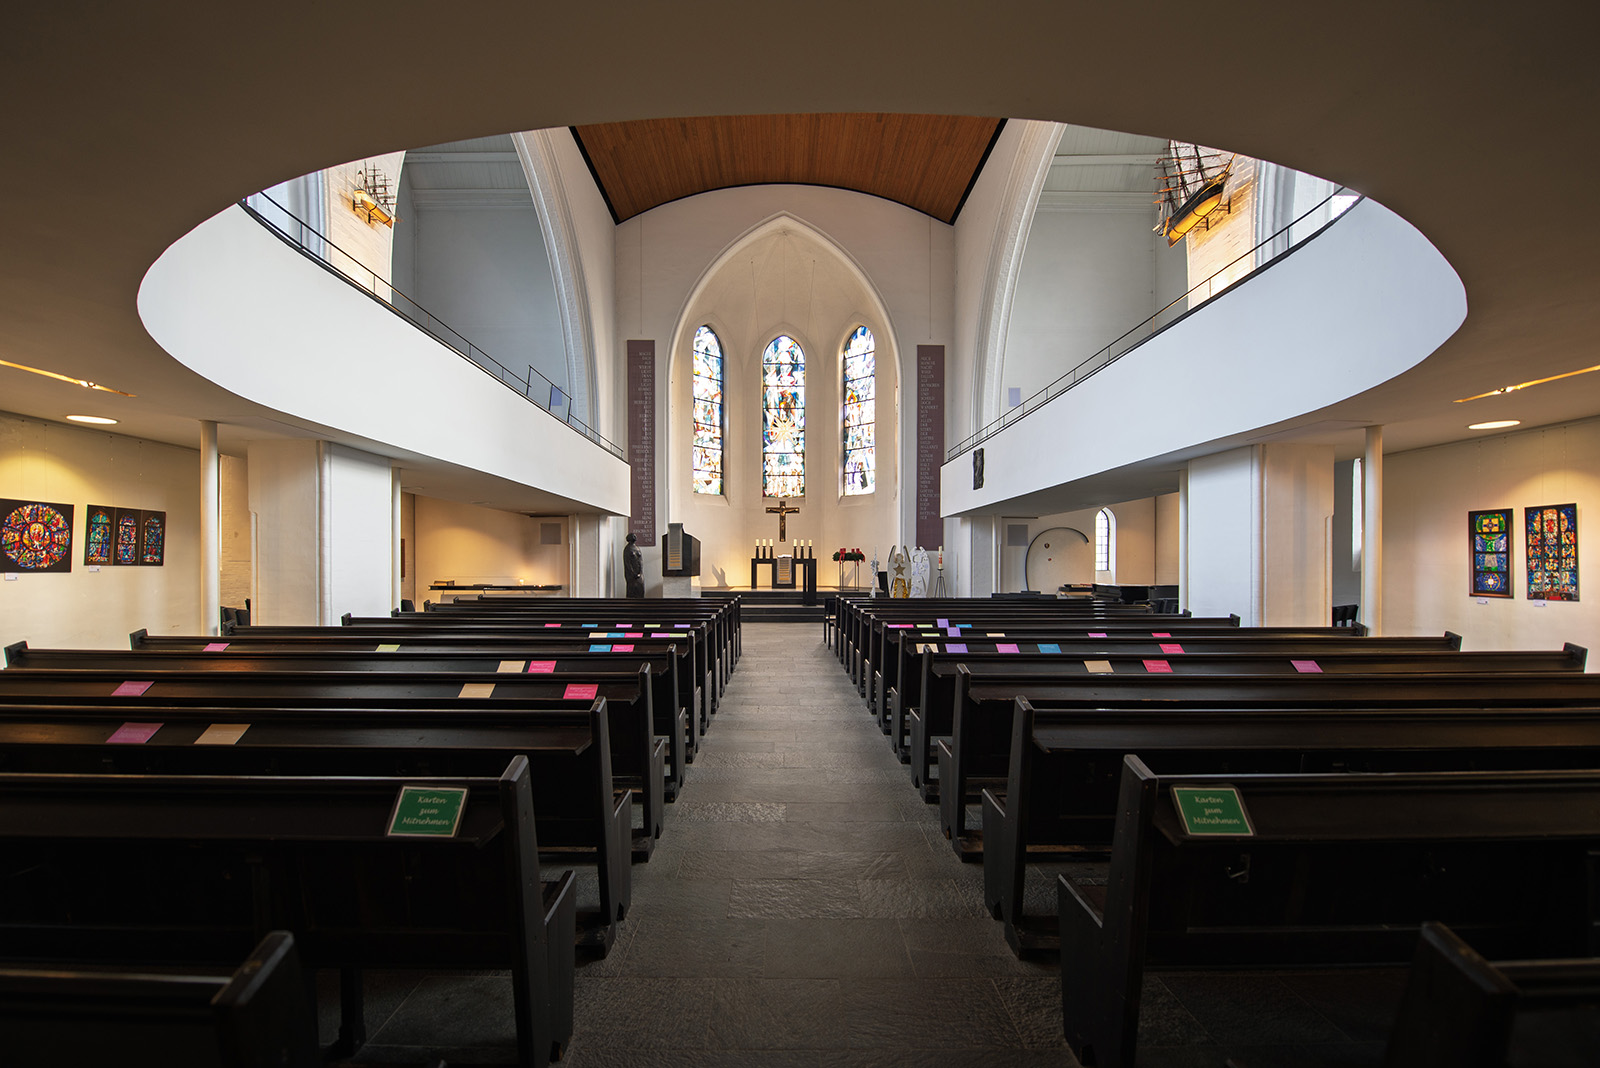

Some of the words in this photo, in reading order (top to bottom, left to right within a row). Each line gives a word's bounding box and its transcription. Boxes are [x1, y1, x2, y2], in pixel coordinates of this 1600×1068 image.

[417, 796, 447, 804] Karten
[1194, 796, 1224, 804] Karten
[419, 808, 439, 816] zum
[1204, 808, 1223, 816] zum
[402, 816, 450, 825] Mitnehmen
[1193, 816, 1240, 825] Mitnehmen
